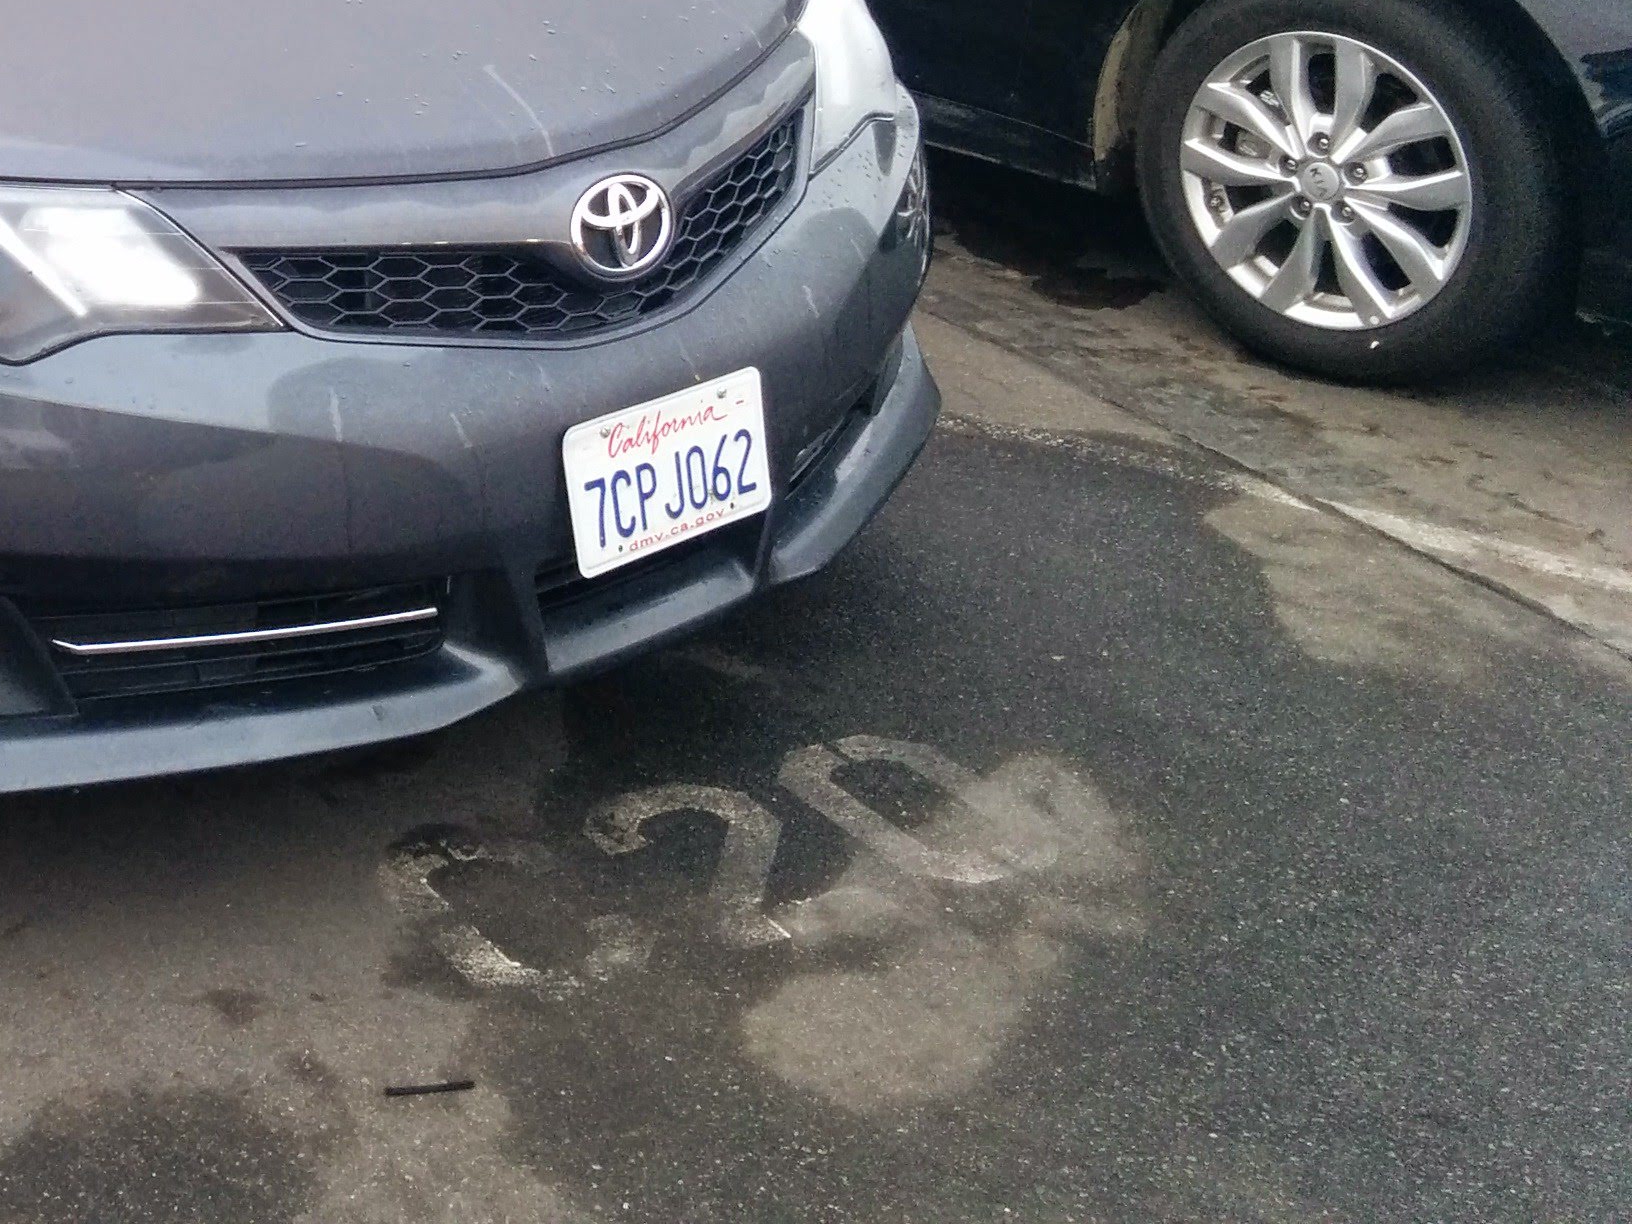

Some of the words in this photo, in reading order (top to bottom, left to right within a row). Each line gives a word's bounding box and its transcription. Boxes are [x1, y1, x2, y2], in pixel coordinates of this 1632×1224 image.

[607, 404, 728, 459] California
[583, 428, 758, 549] 7CPJ062
[628, 507, 726, 553] dmv.ca.gov
